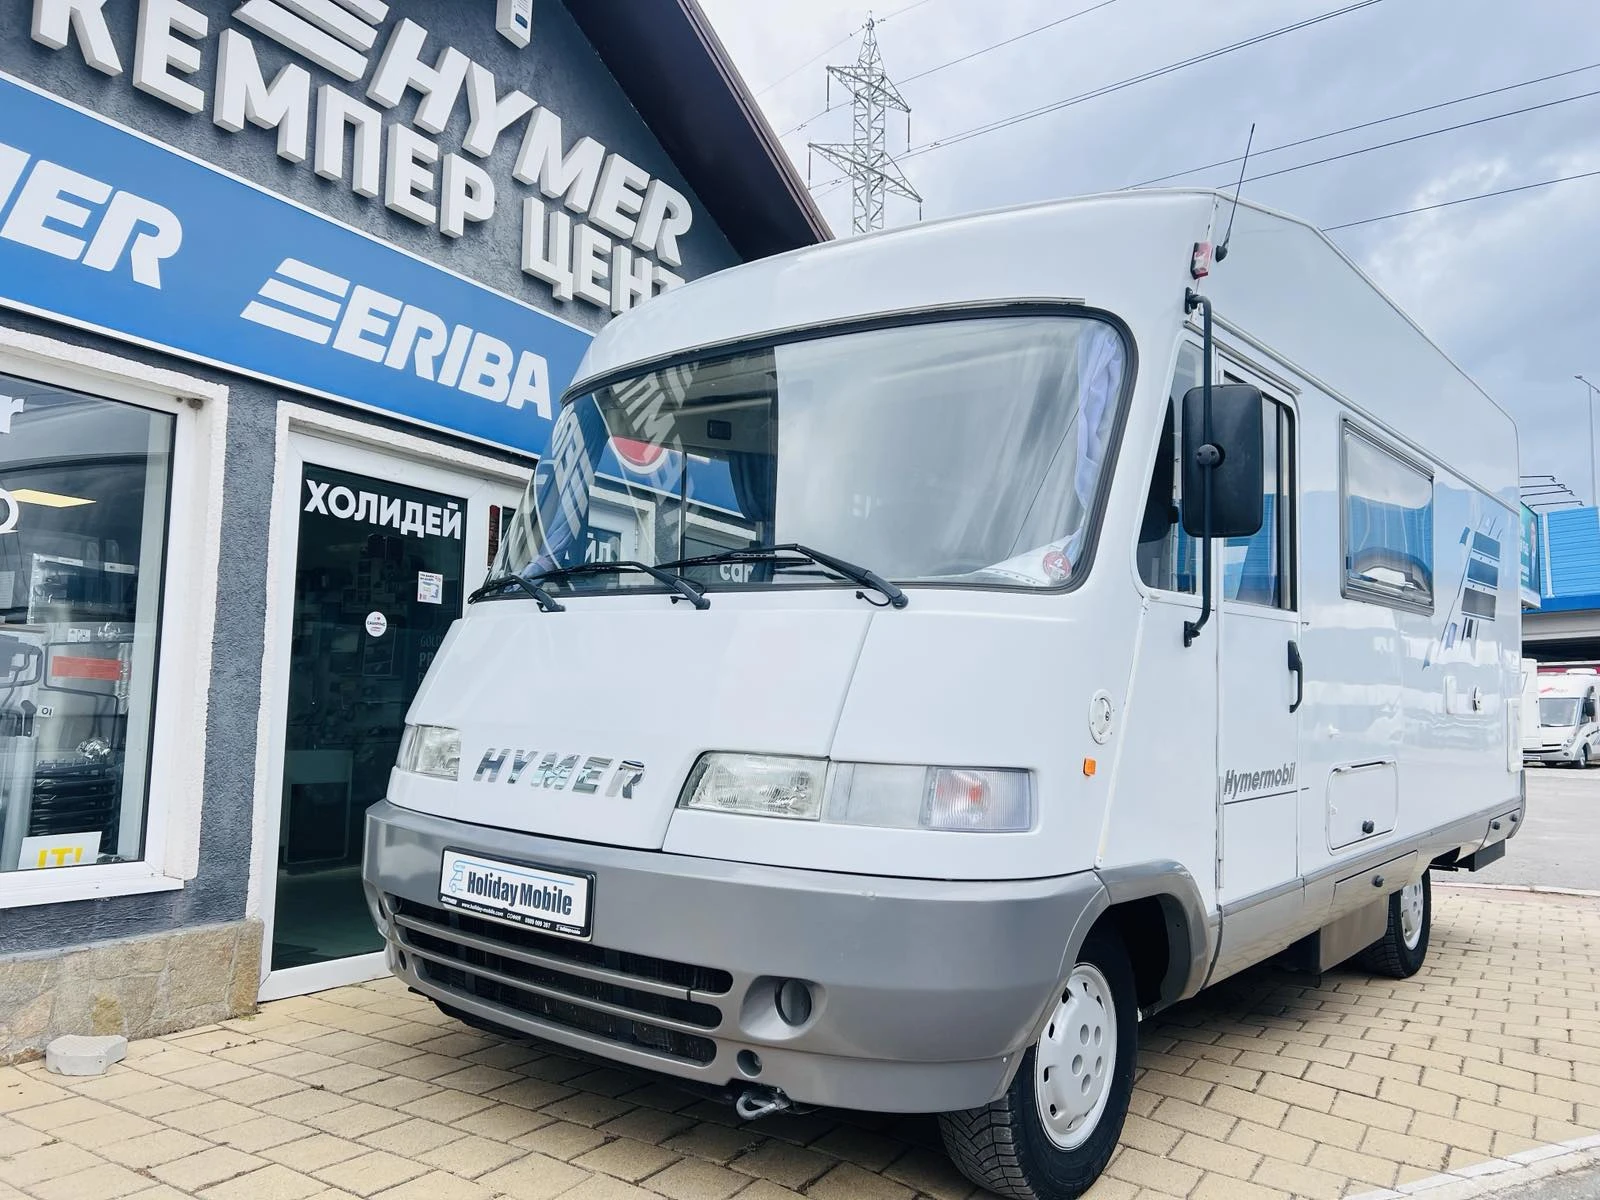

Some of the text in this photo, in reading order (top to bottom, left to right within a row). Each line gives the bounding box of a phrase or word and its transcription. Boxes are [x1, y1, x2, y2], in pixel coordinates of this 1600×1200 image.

[31, 0, 495, 239] КЕМПЕР
[366, 17, 692, 267] HYMER
[332, 284, 552, 421] ERIBA
[303, 478, 462, 540] ХОЛИДЕЙ
[473, 748, 645, 799] HYMER
[1224, 762, 1296, 799] Hymermobil
[467, 871, 573, 916] Holiday Mobile
